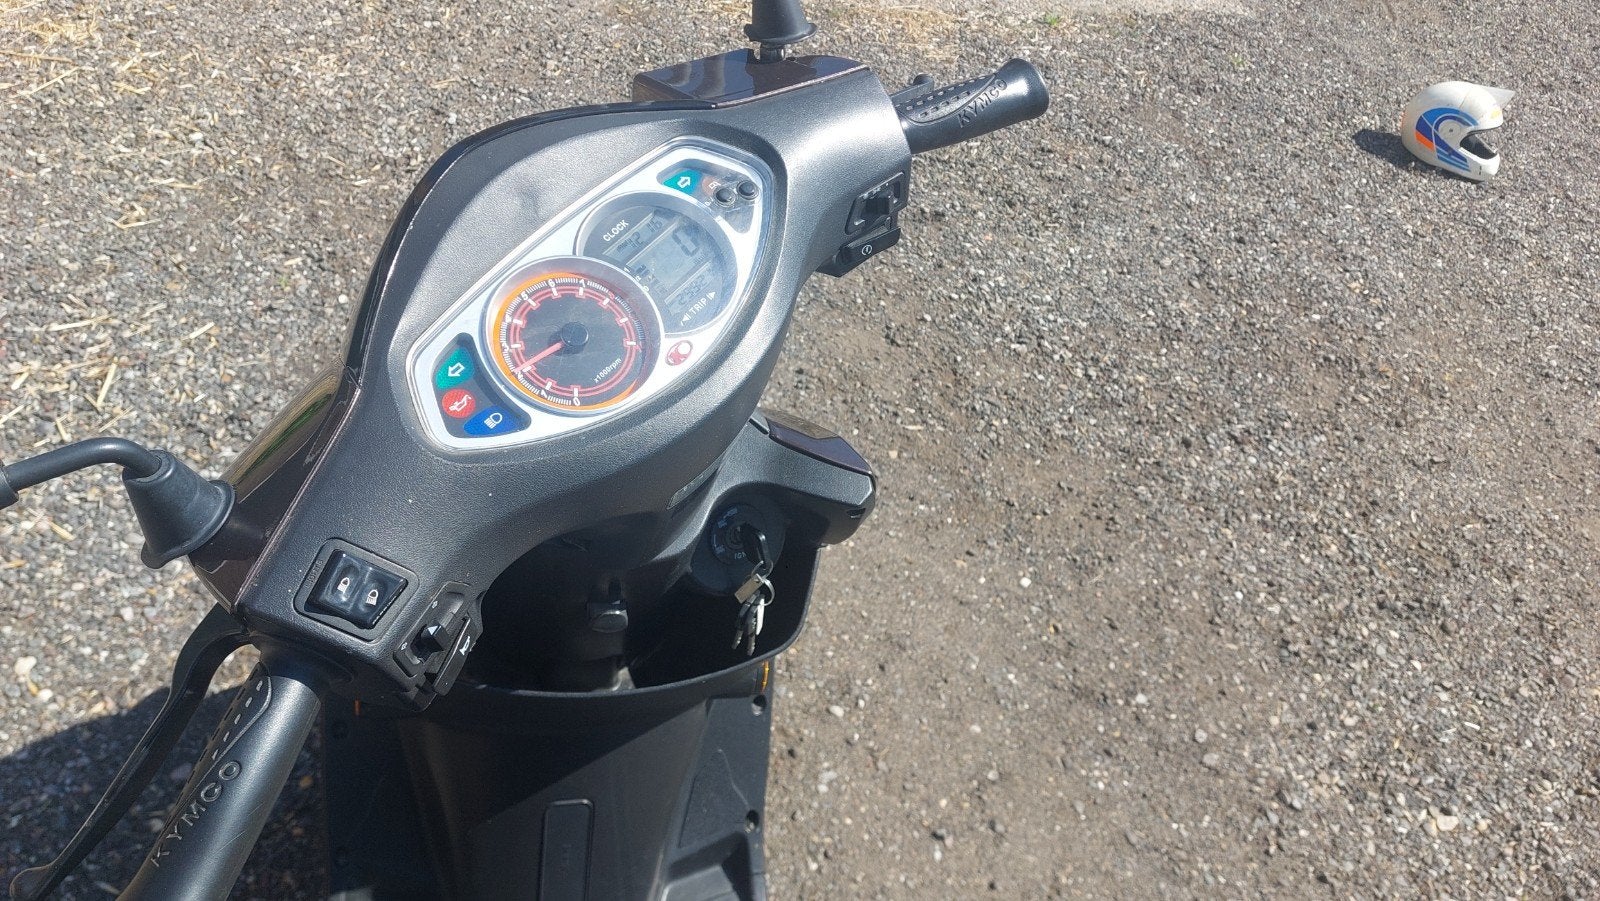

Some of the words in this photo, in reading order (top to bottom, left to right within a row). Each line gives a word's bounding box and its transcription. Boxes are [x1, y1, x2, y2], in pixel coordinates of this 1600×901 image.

[957, 79, 1007, 128] KYMCO
[602, 219, 629, 241] CLOCK
[547, 279, 556, 288] 6
[520, 291, 529, 301] 5
[689, 297, 707, 315] TRIP
[593, 357, 622, 383] x1000rpm
[572, 396, 581, 407] 0
[150, 760, 242, 868] KYMCO
